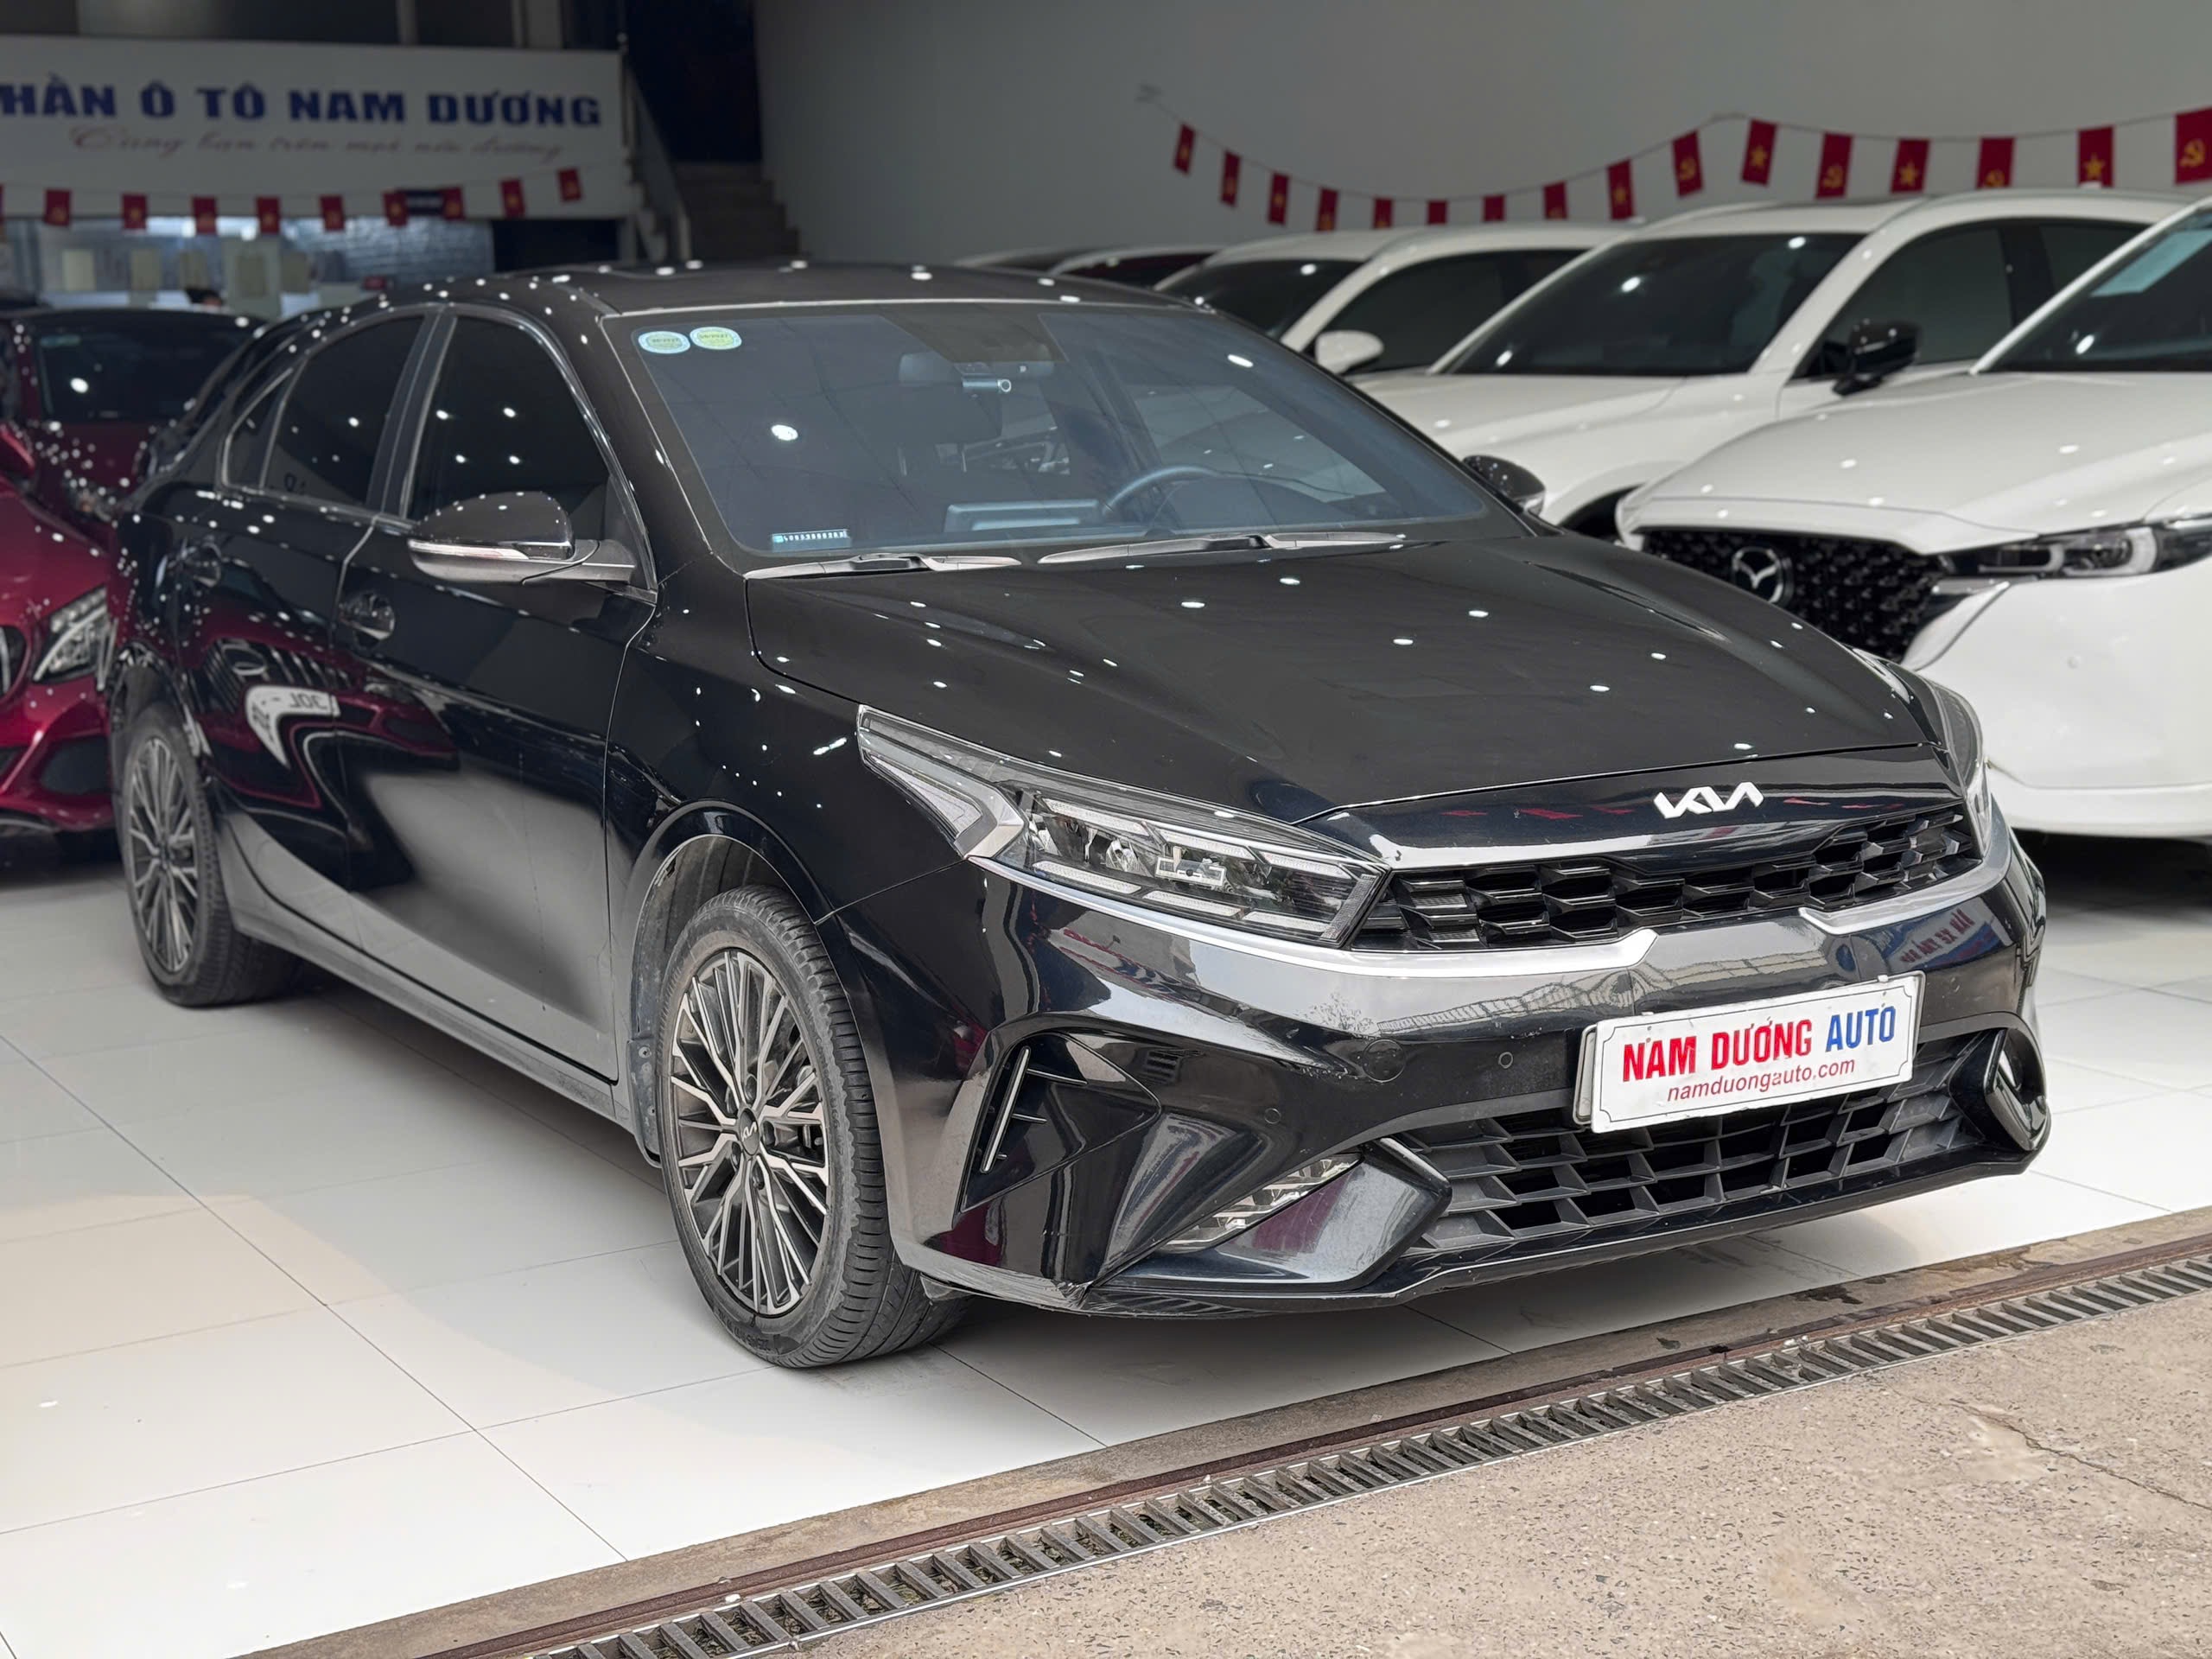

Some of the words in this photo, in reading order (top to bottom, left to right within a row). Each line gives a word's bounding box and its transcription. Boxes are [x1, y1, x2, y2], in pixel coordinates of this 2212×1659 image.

[140, 79, 176, 118] Ô
[196, 81, 266, 119] TÔ
[289, 90, 405, 122] NAM
[427, 88, 601, 127] DƯƠNG
[1654, 782, 1764, 819] KIA
[1622, 1036, 1697, 1082] NAM
[1711, 1017, 1813, 1071] DƯƠNG
[1825, 1005, 1897, 1052] AUTO
[1667, 1058, 1856, 1103] namduongauto.com
